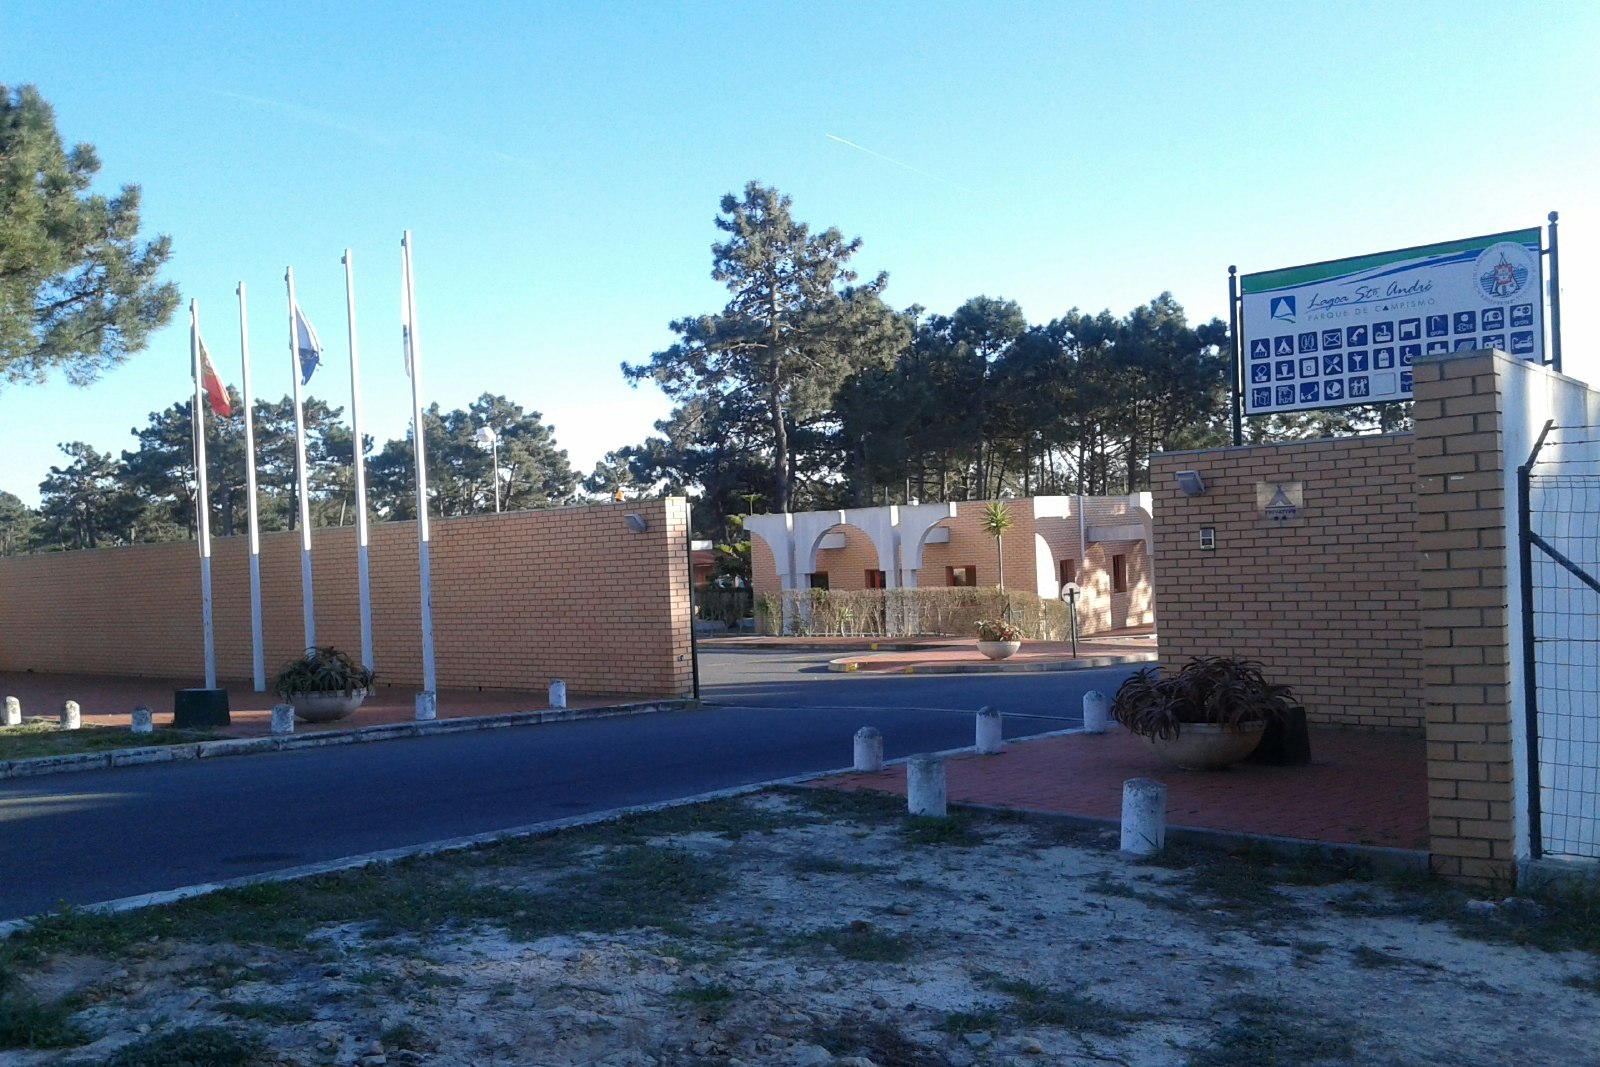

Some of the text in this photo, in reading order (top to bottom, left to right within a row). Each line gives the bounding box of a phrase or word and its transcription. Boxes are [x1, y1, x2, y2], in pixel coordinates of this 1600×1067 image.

[1307, 292, 1349, 311] Lagoa
[1386, 279, 1434, 297] André
[1308, 310, 1349, 321] PARQUE
[1354, 307, 1368, 316] DE
